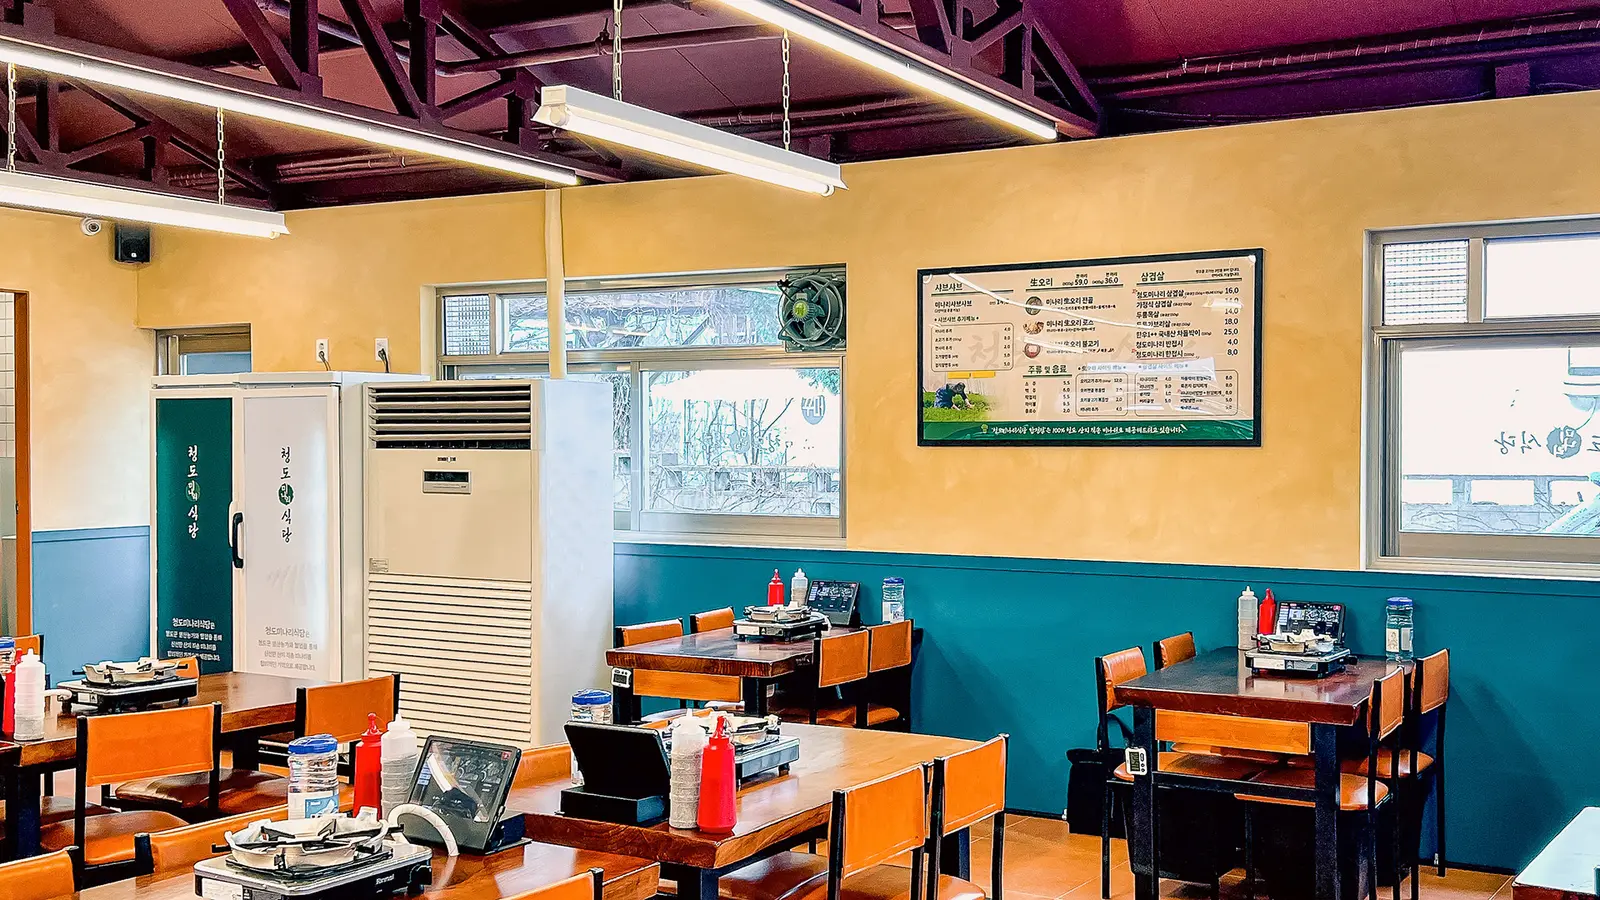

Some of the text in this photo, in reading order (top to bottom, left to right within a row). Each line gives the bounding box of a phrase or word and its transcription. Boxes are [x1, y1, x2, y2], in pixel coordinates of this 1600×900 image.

[1140, 272, 1164, 282] 삼겹살
[1030, 278, 1053, 287] 生오리
[935, 284, 962, 292] 샤브샤브
[1166, 289, 1184, 298] 삼겹살
[1082, 340, 1100, 348] 불고기
[1028, 366, 1043, 374] 주류
[1052, 364, 1068, 374] 음료
[265, 626, 311, 638] 청도미나리식당은
